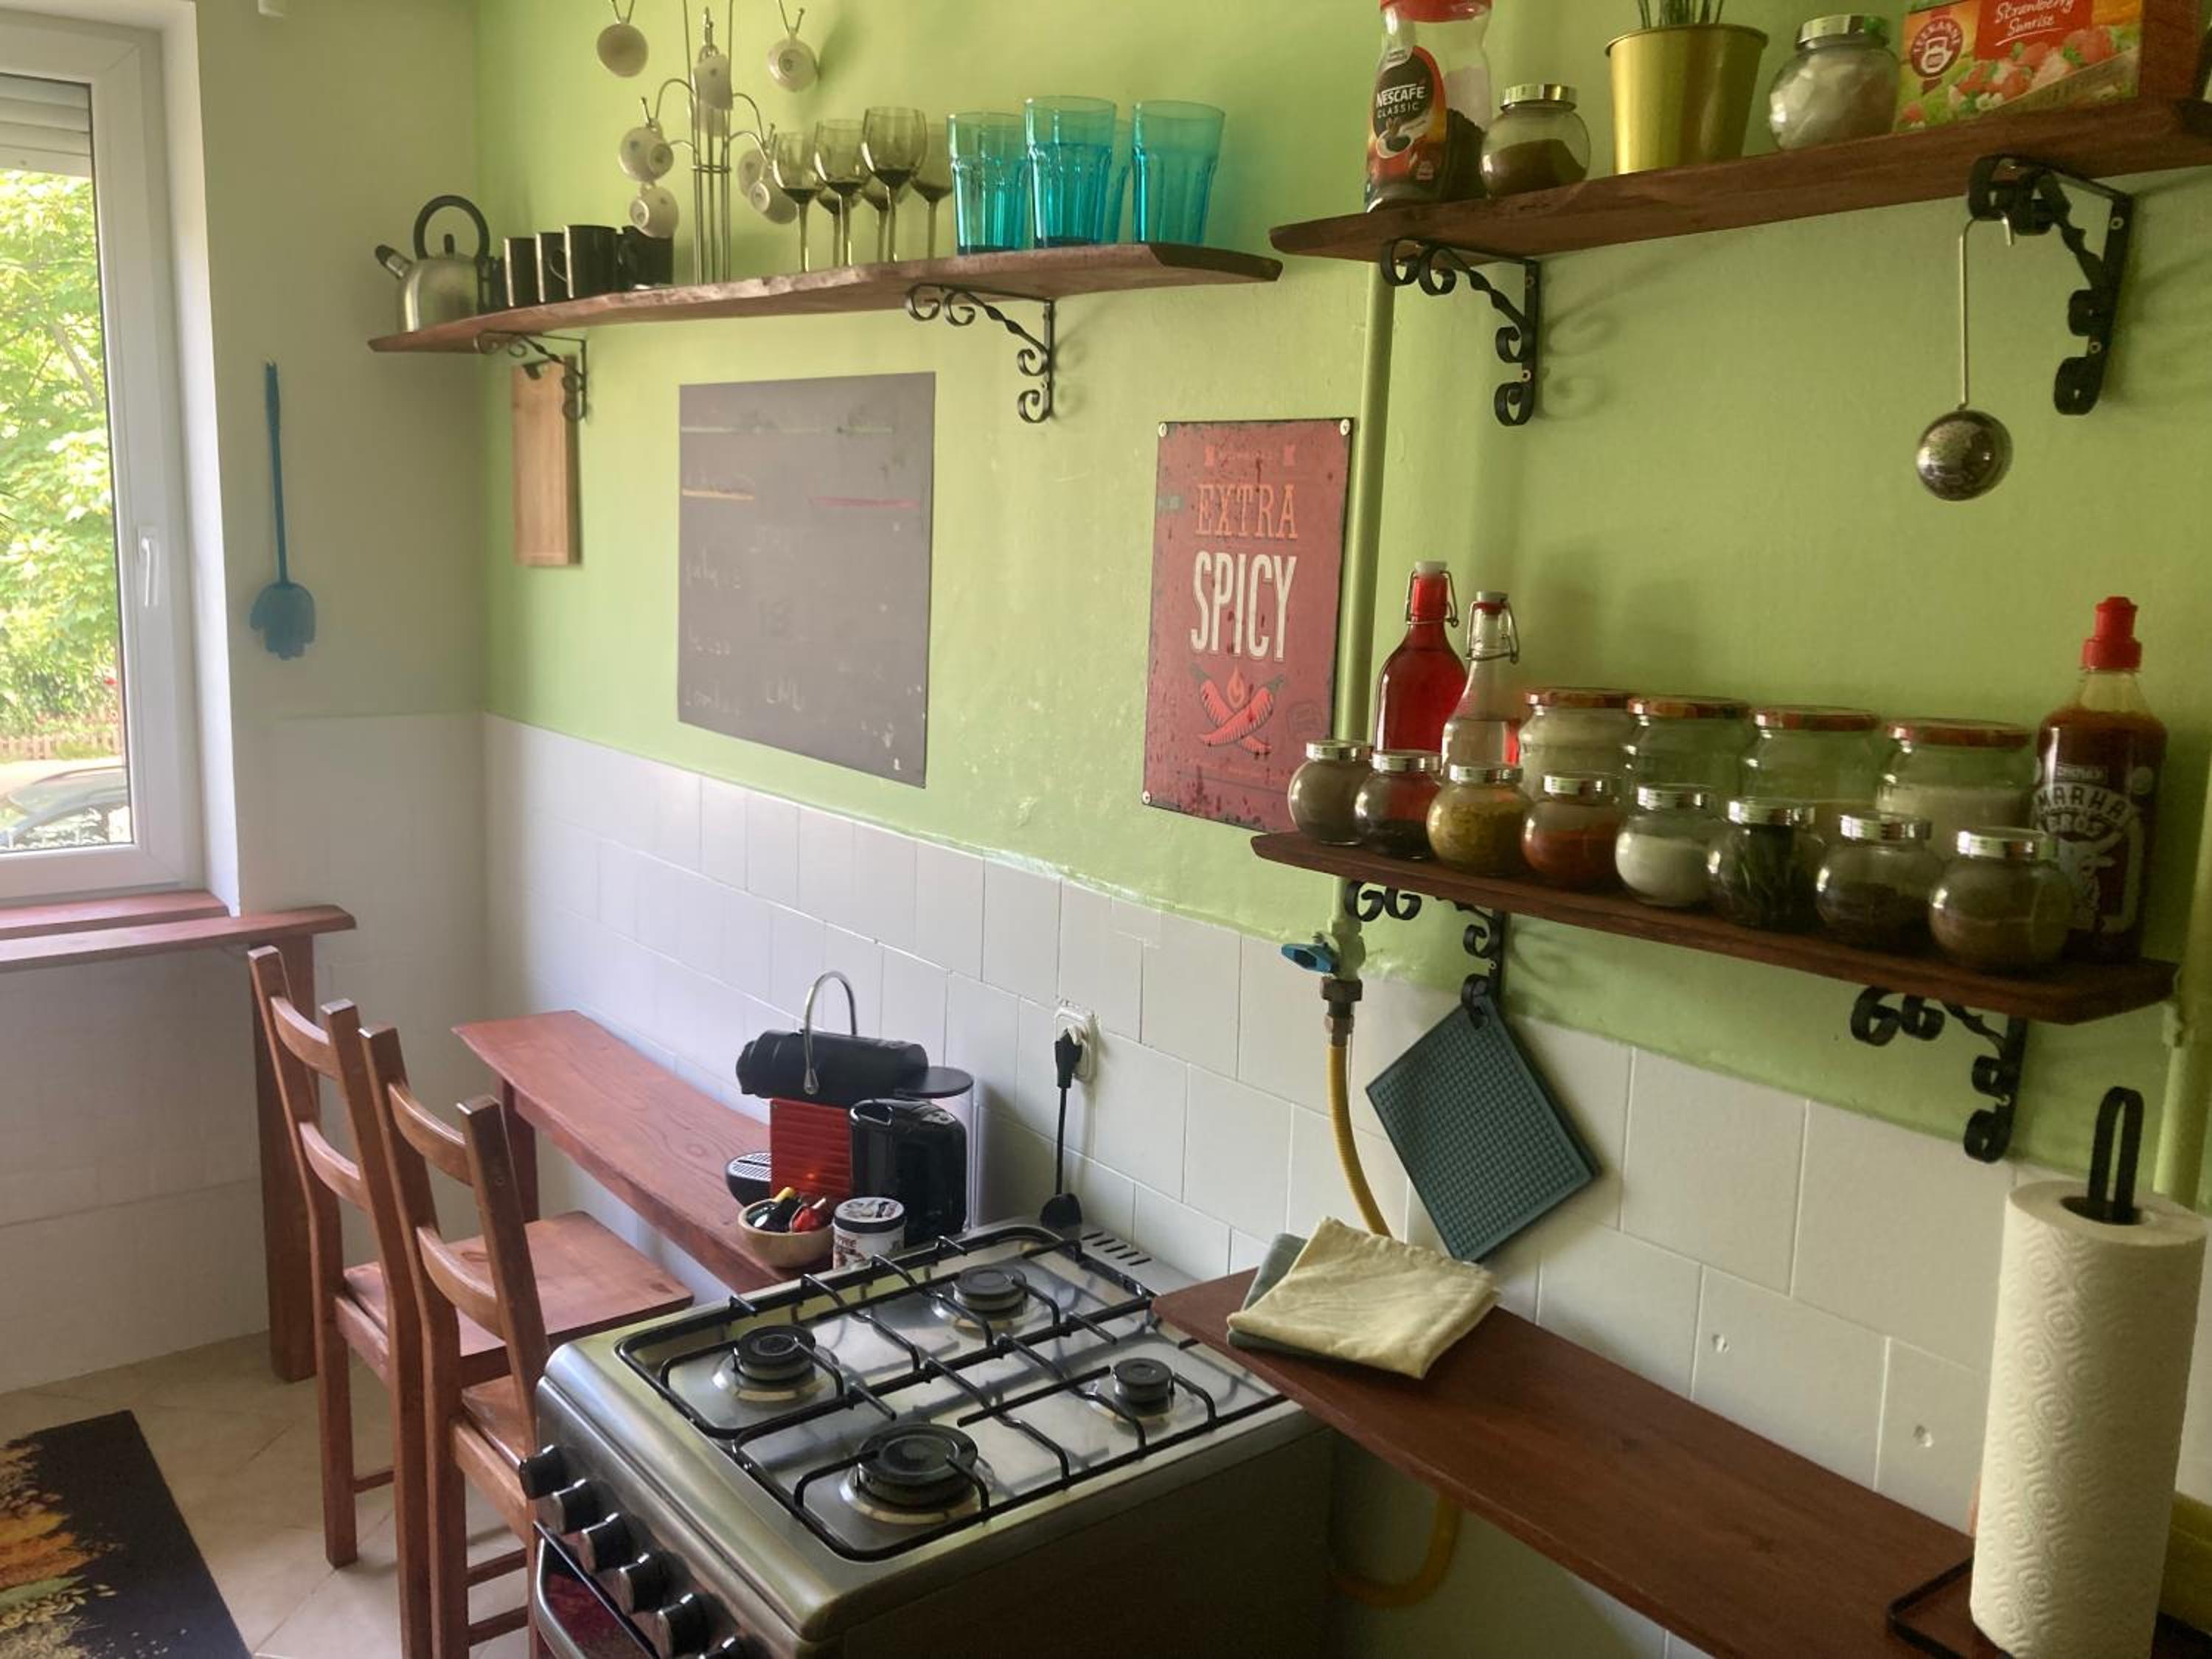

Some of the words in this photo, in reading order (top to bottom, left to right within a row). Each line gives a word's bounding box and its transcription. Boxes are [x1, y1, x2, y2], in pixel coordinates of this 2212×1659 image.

[2006, 15, 2054, 36] Sunrise
[1377, 102, 1419, 119] CLASSIC
[1195, 483, 1298, 539] EXTRA
[1191, 550, 1298, 661] SPICY
